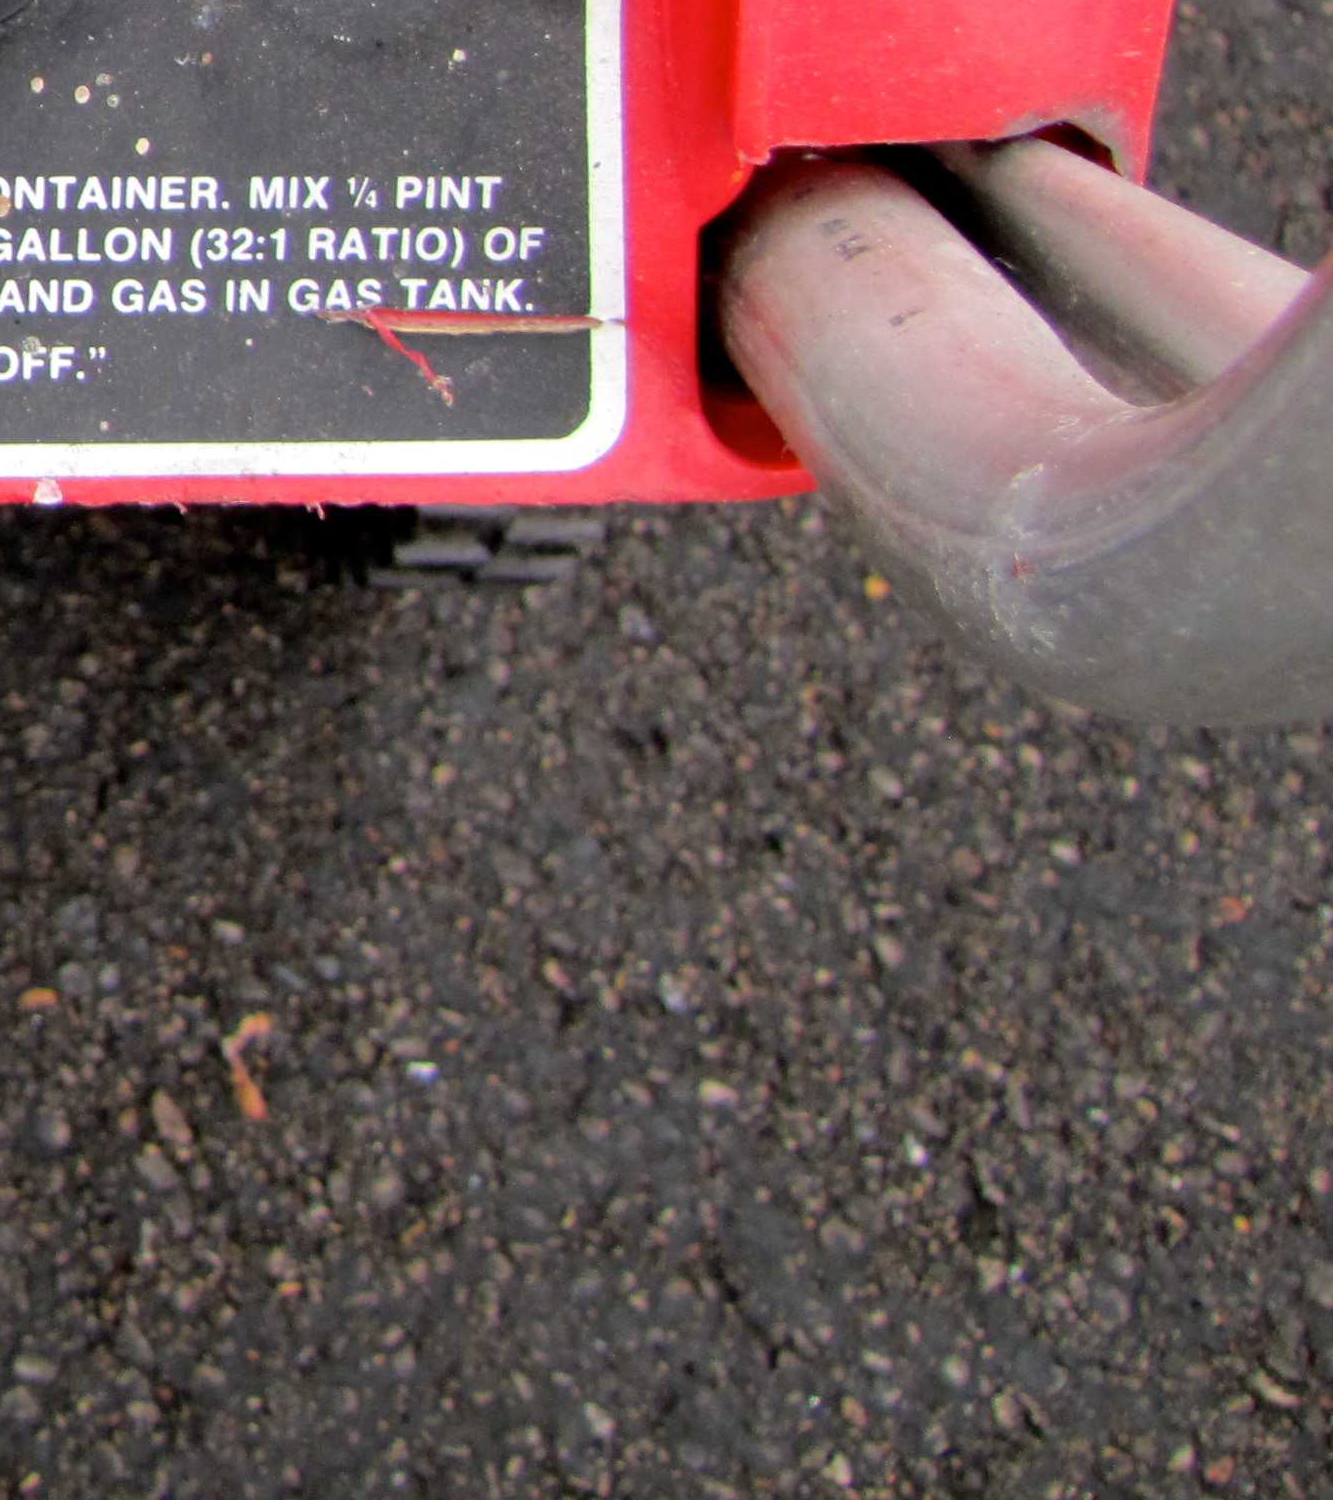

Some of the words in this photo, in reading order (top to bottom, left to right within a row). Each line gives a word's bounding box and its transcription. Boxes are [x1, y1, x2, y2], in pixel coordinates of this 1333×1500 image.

[249, 176, 330, 210] MIX
[396, 175, 503, 210] PINT
[190, 227, 286, 270] (32:1
[308, 226, 465, 269] RATIO)
[483, 226, 545, 262] OF
[111, 278, 207, 314] GAS
[225, 278, 270, 312] IN
[288, 278, 382, 313] GAS
[399, 278, 534, 312] TANK.
